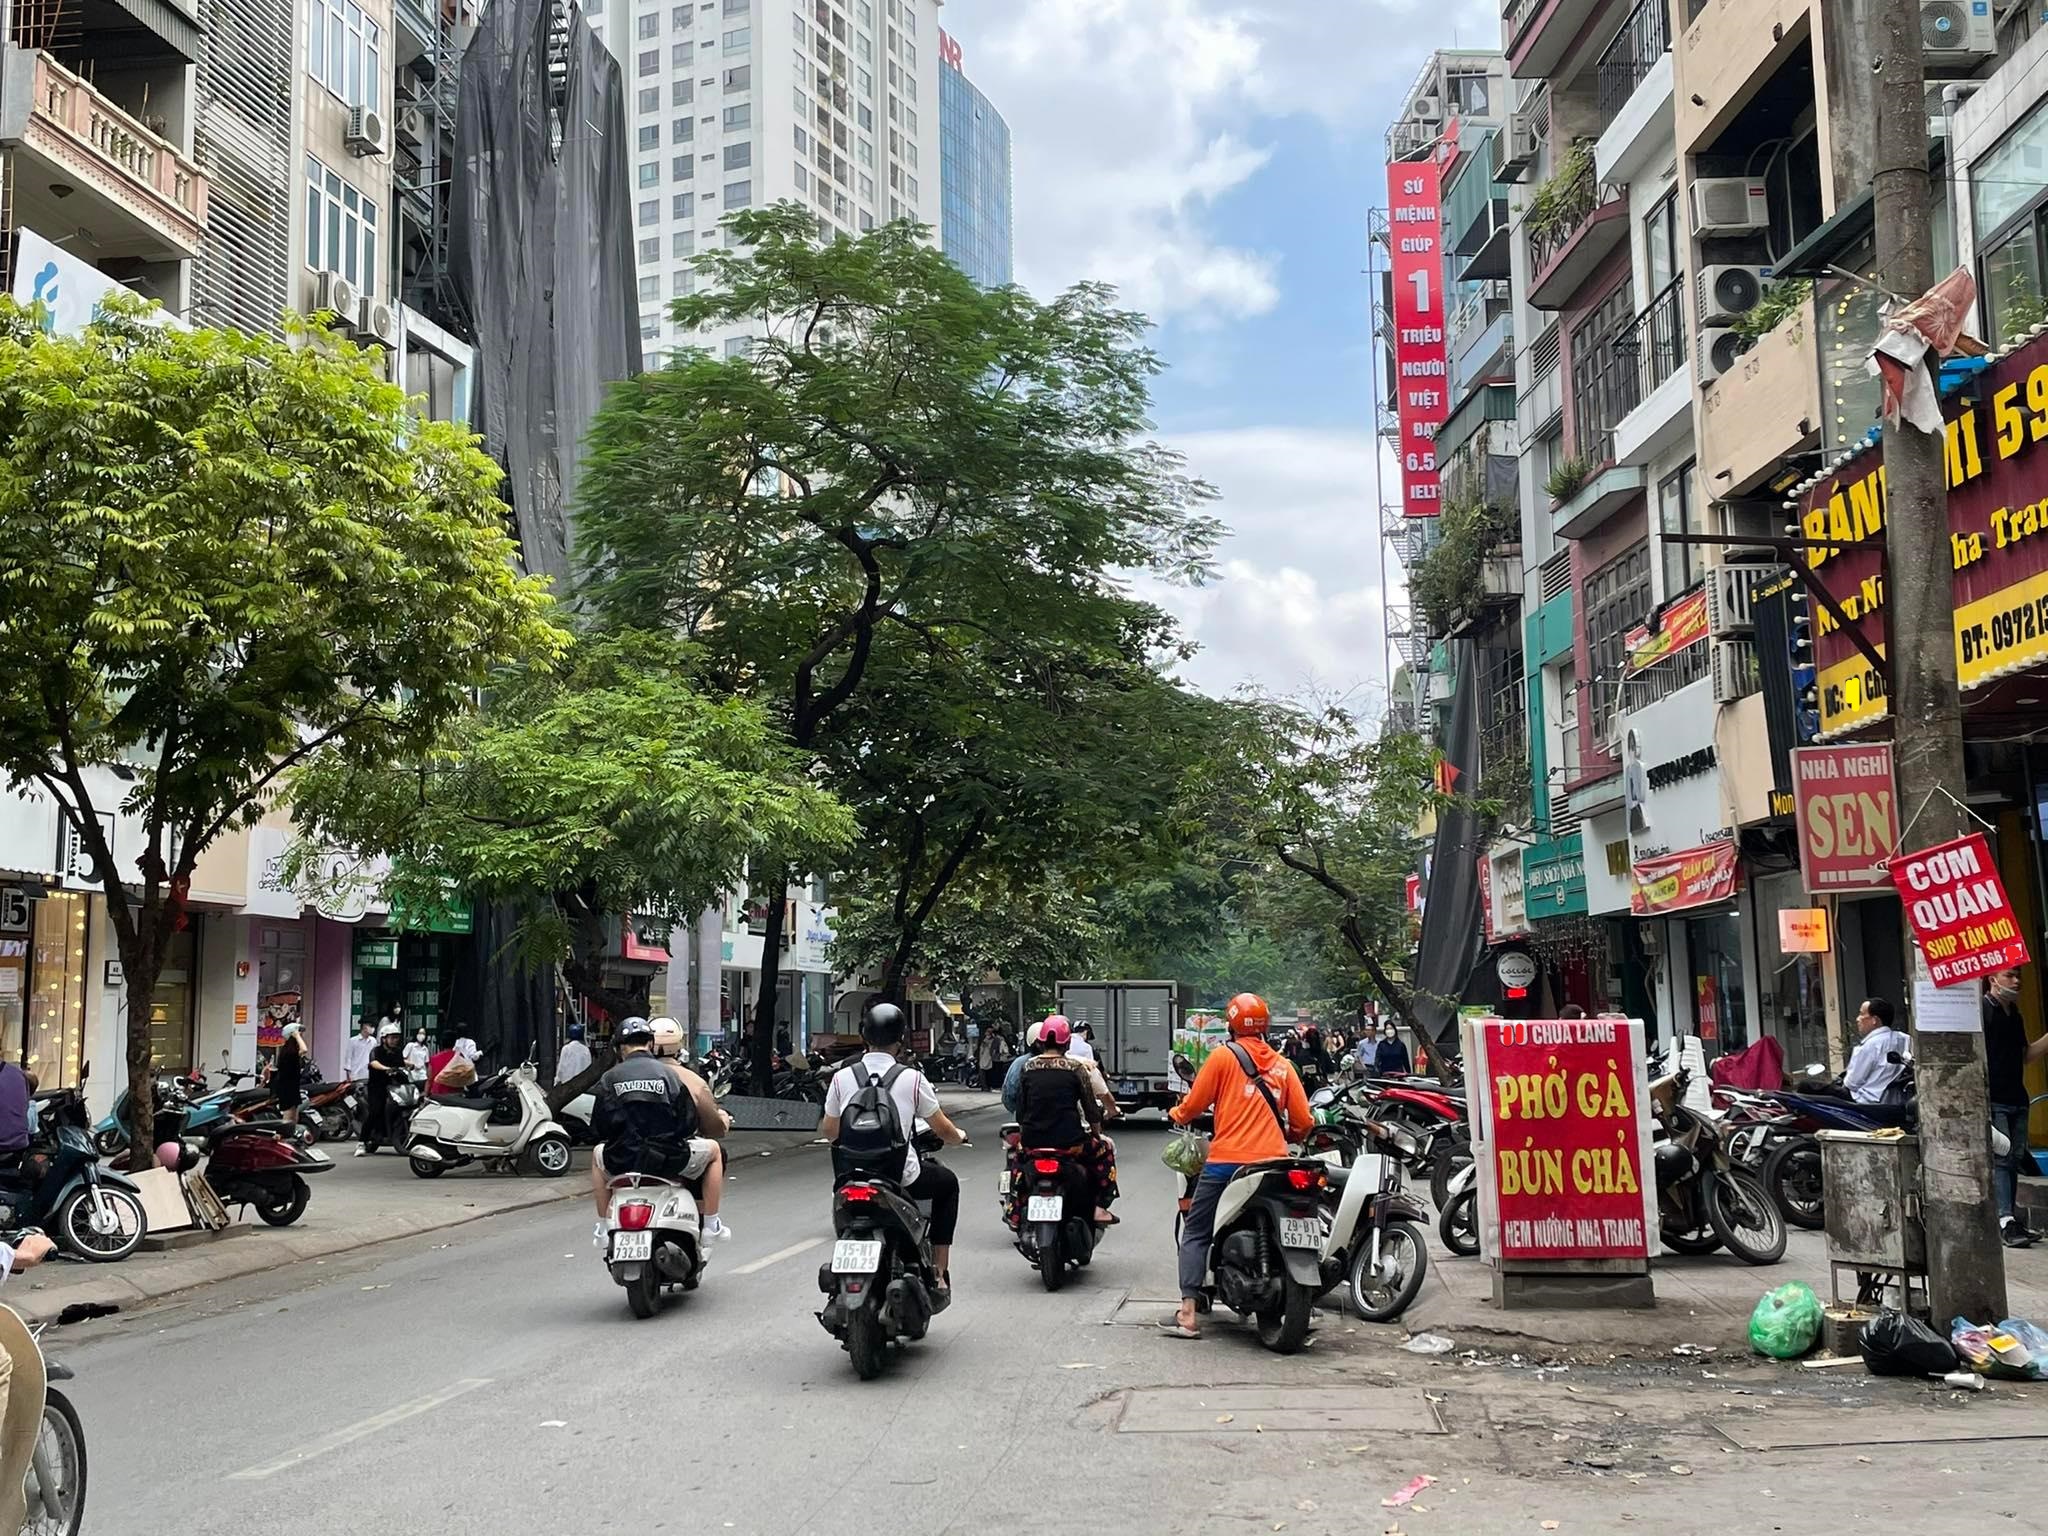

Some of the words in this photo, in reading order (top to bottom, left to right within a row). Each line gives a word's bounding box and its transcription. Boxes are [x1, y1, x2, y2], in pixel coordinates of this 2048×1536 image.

[1404, 176, 1424, 195] SỨ
[1395, 204, 1436, 224] MỆNH
[1401, 234, 1433, 252] GIÚP
[1408, 269, 1430, 313] 1
[1401, 325, 1442, 346] TRIỆU
[1402, 357, 1445, 377] NGƯỜI
[1409, 389, 1440, 409] VIỆT
[1413, 422, 1440, 440] ĐẠT
[1410, 485, 1441, 500] IELT
[1950, 531, 1983, 570] ha
[1991, 602, 2036, 651] 0972
[1800, 754, 1840, 780] NHÀ
[1843, 748, 1889, 778] NGHỈ
[1807, 791, 1892, 859] SEN
[1906, 845, 1981, 891] CƠM
[1913, 879, 2003, 932] QUÁN
[1926, 934, 1958, 960] SHIP
[1958, 925, 1990, 952] TẬN
[1987, 917, 2016, 942] NƠI
[1932, 964, 1953, 981] ĐT:
[1951, 956, 1981, 977] 0373
[1980, 949, 2003, 969] 566
[1495, 1055, 1568, 1119] PHỞ
[1576, 1058, 1631, 1118] GÀ
[1500, 1136, 1564, 1195] BÚN
[1571, 1129, 1639, 1194] CHẢ
[1504, 1220, 1532, 1248] NEM
[1534, 1211, 1575, 1248] NƯỚNG
[1576, 1218, 1602, 1247] NHA
[1602, 1218, 1643, 1247] TRANG
